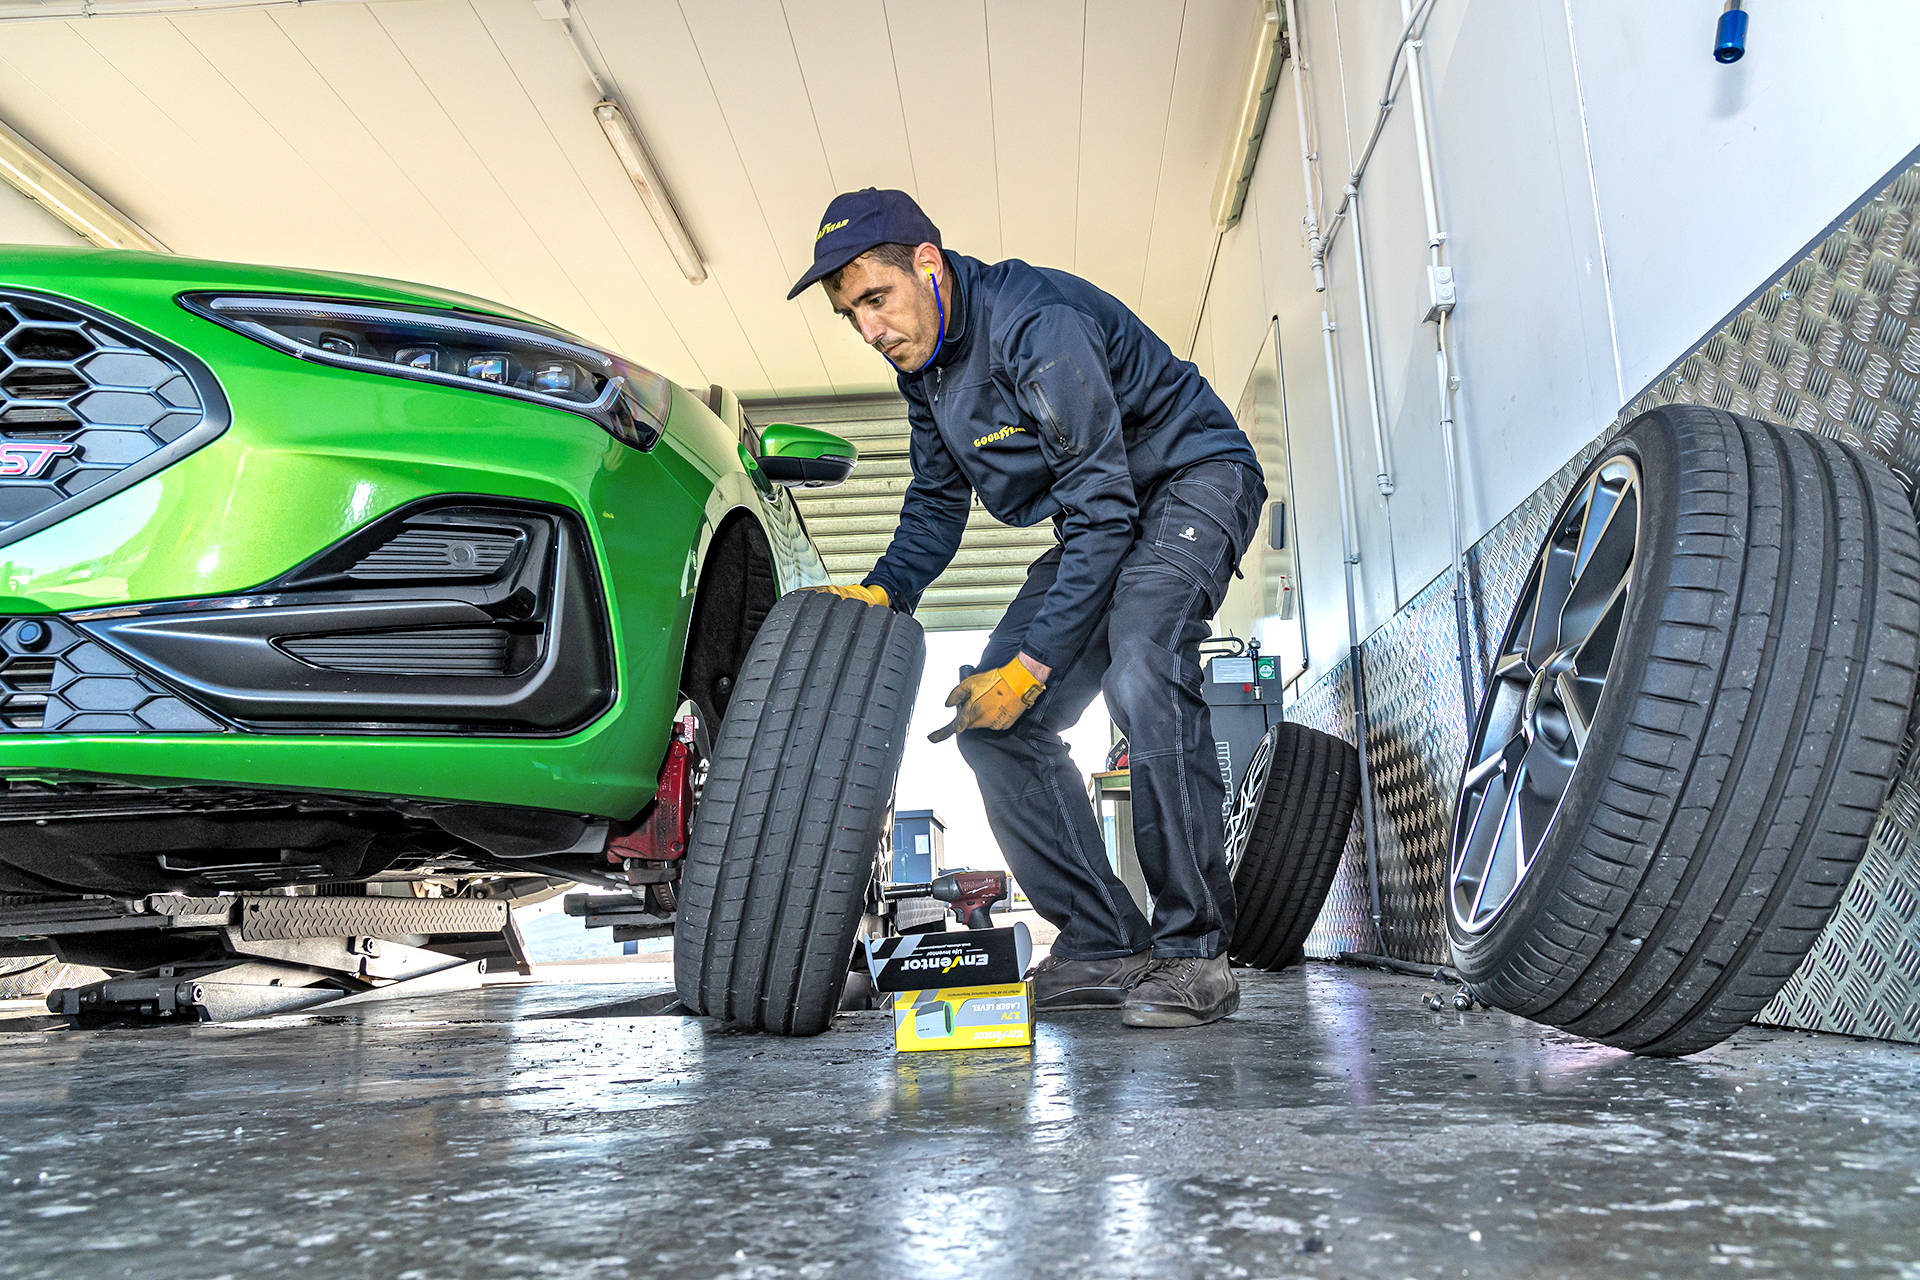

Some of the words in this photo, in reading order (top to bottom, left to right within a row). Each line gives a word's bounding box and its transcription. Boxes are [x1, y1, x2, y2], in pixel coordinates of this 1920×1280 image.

[0, 443, 74, 476] ST
[972, 1003, 995, 1011] LEVEL
[996, 1002, 1020, 1011] LASER
[1001, 1011, 1020, 1020] 3.7V
